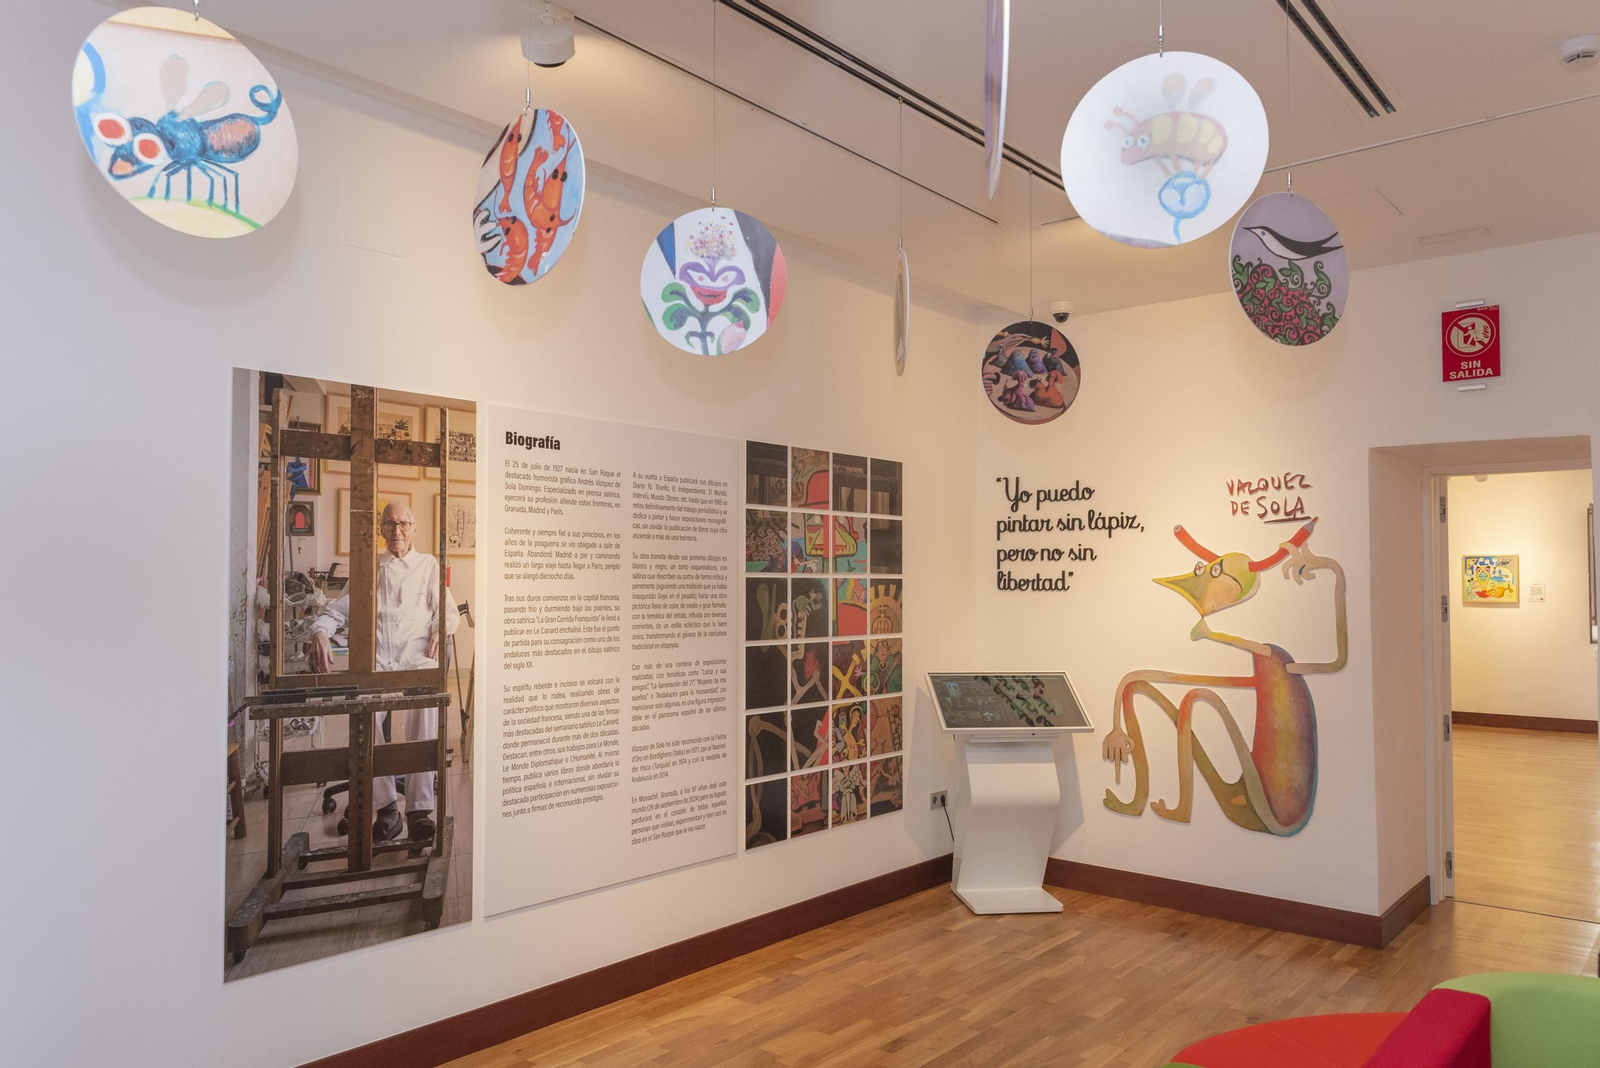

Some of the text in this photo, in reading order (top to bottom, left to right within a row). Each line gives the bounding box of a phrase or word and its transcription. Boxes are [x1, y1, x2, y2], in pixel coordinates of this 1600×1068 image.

[1460, 360, 1481, 370] SIN
[1449, 368, 1494, 380] SALIDA
[506, 431, 560, 450] Biografía
[505, 459, 511, 468] El
[511, 460, 519, 469] 25
[521, 461, 528, 470] de
[530, 462, 542, 473] julio
[544, 463, 550, 472] de
[552, 464, 563, 473] 1927
[565, 465, 579, 474] nacía
[589, 468, 598, 476] San
[600, 469, 615, 480] Roque
[616, 470, 621, 478] el
[505, 470, 621, 490] destacado humorista gráfico Andrés Vázquez de
[1226, 472, 1313, 496] VAZQUEZ
[505, 482, 517, 491] Sola
[544, 485, 577, 498] Especializado
[586, 490, 602, 500] prensa
[1036, 480, 1095, 510] puedo
[504, 493, 526, 505] ejercerá
[535, 495, 558, 507] profesión
[559, 497, 577, 506] allende
[578, 498, 591, 507] estas
[528, 505, 546, 515] Madrid
[1230, 496, 1306, 519] DE SOLA
[997, 510, 1145, 540] pintar sin lápiz,
[504, 526, 531, 536] Coherente
[537, 528, 557, 539] siempre
[558, 529, 566, 537] fiel
[504, 538, 518, 546] años
[519, 538, 526, 547] de
[527, 538, 533, 547] la
[534, 541, 560, 550] posguerra
[577, 540, 598, 551] obligado
[603, 542, 613, 550] salir
[527, 549, 553, 558] Abandonó
[555, 550, 572, 559] Madrid
[580, 551, 588, 561] pie
[595, 552, 621, 560] caminando
[997, 544, 1097, 570] pero no sin
[504, 560, 522, 569] realizó
[531, 561, 544, 571] largo
[545, 561, 557, 572] viaje
[558, 561, 571, 570] hasta
[572, 562, 586, 572] llegar
[605, 562, 620, 572] periplo
[504, 573, 514, 582] que
[522, 572, 539, 582] alargó
[539, 572, 563, 580] dieciocho
[504, 594, 515, 602] Tras
[526, 594, 541, 602] duros
[542, 594, 569, 602] comienzos
[577, 594, 582, 602] la
[583, 594, 599, 604] capital
[504, 605, 527, 616] pasando
[528, 605, 537, 613] frío
[544, 604, 571, 613] durmiendo
[572, 604, 583, 614] bajo
[504, 616, 516, 625] obra
[516, 616, 536, 624] satírica
[544, 615, 556, 624] Gran
[557, 615, 574, 623] Corrida
[606, 614, 616, 622] llevó
[503, 639, 511, 647] de
[511, 638, 530, 649] partida
[531, 639, 542, 648] para
[550, 636, 582, 648] consagración
[504, 649, 531, 659] andaluces
[532, 648, 543, 657] más
[544, 647, 572, 656] destacados
[582, 646, 586, 655] el
[588, 646, 602, 656] dibujo
[603, 645, 620, 653] satírico
[503, 661, 512, 670] del
[513, 661, 526, 672] siglo
[503, 684, 511, 693] Su
[512, 682, 532, 694] espíritu
[534, 681, 553, 690] rebelde
[559, 679, 578, 688] incisivo
[587, 677, 604, 686] volcará
[615, 676, 620, 684] la
